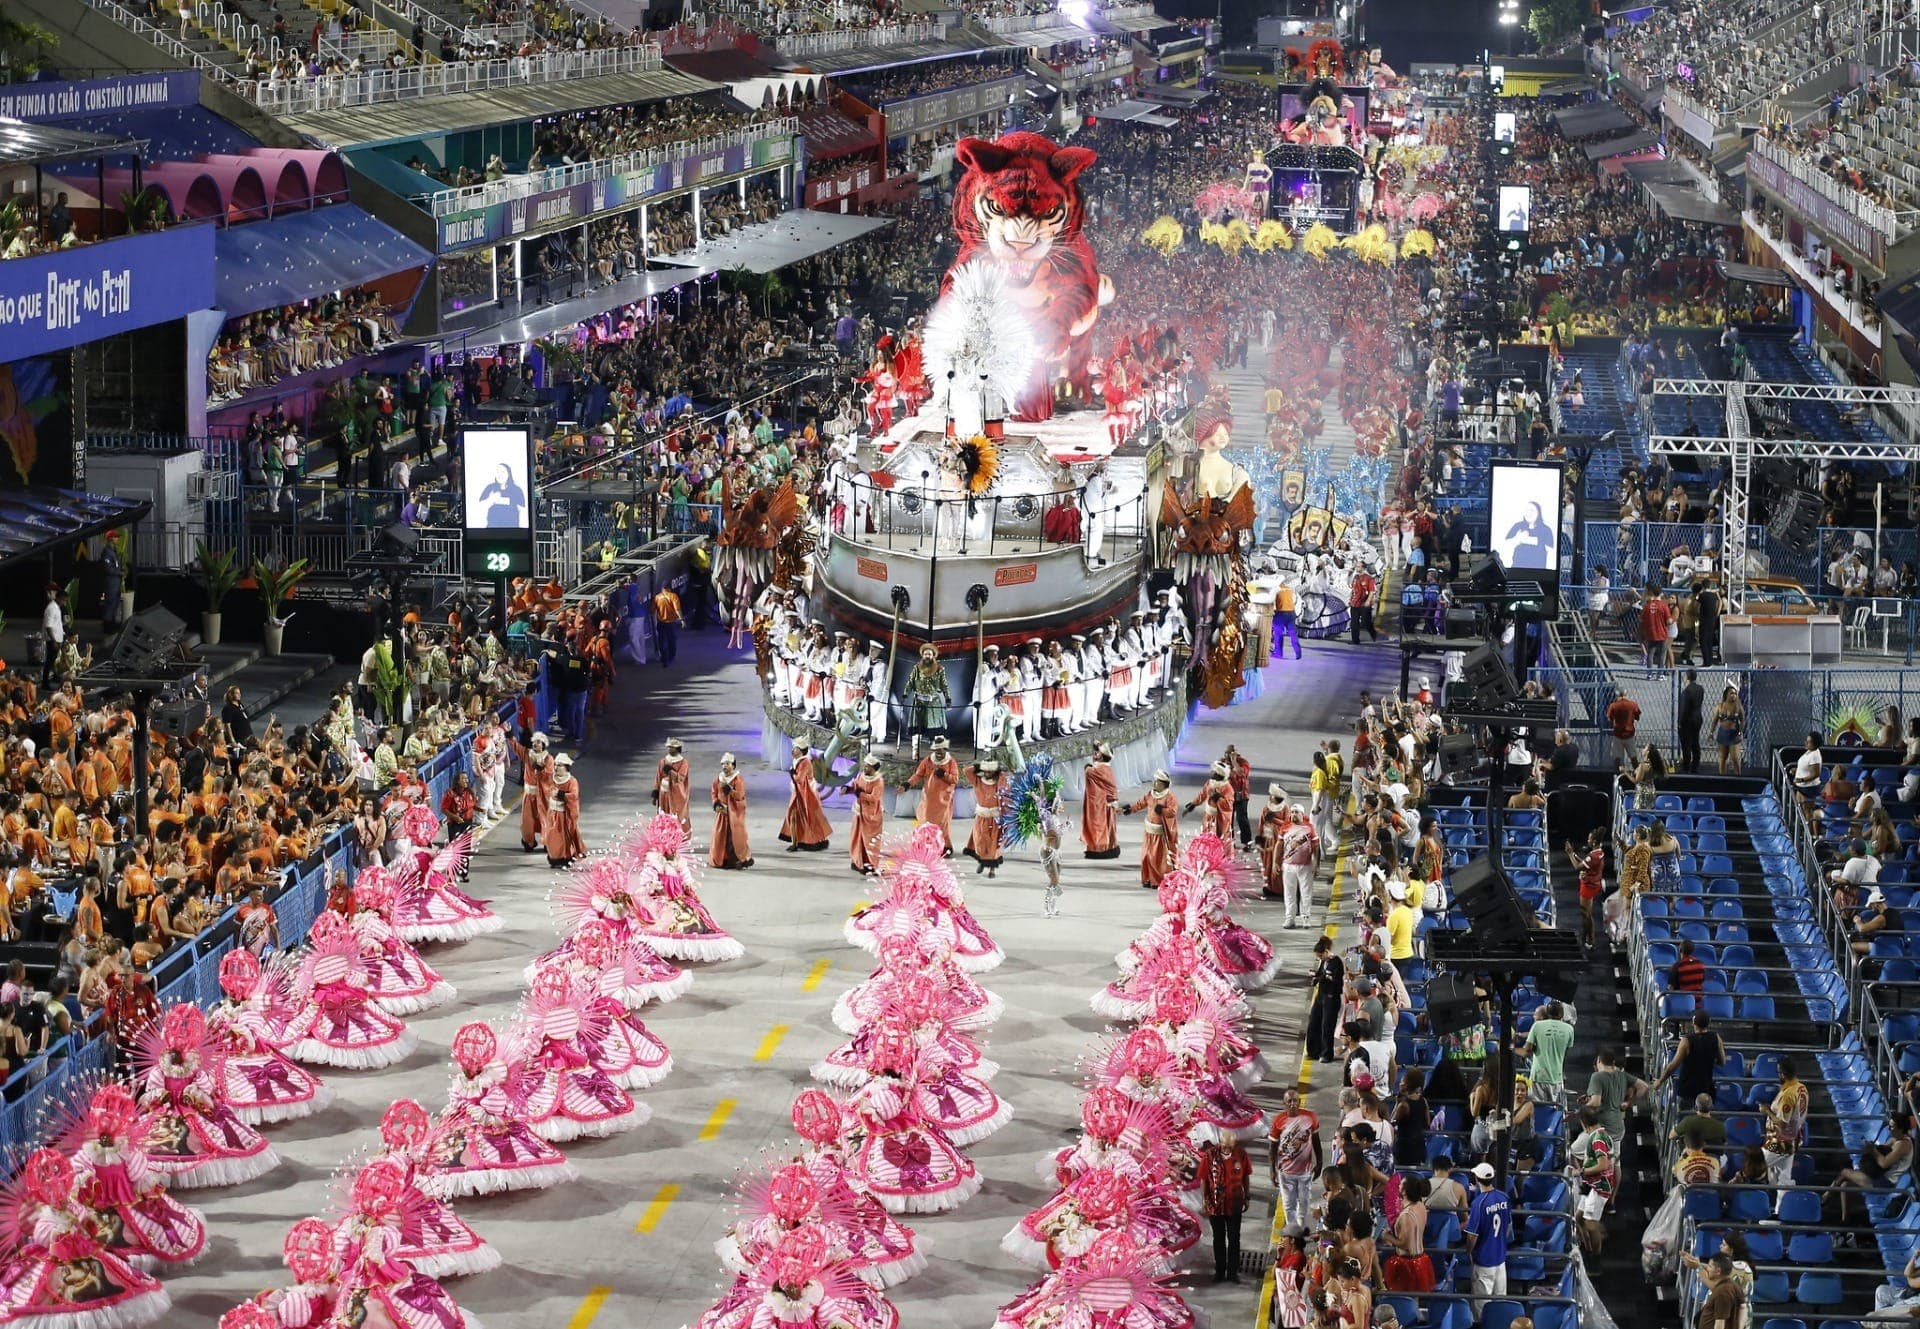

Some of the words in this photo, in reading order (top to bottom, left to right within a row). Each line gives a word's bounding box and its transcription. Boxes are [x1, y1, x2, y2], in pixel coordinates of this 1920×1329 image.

[16, 93, 46, 117] FUNDA
[49, 93, 55, 115] O
[57, 86, 80, 113] CHÃO
[85, 81, 124, 111] CONSTRÓI
[127, 85, 133, 105] O
[134, 77, 168, 104] AMANHÃ
[18, 292, 42, 325] QUE
[47, 271, 80, 330] BATE
[102, 269, 130, 317] PEITO
[487, 553, 510, 571] 29
[1493, 1213, 1501, 1238] 9
